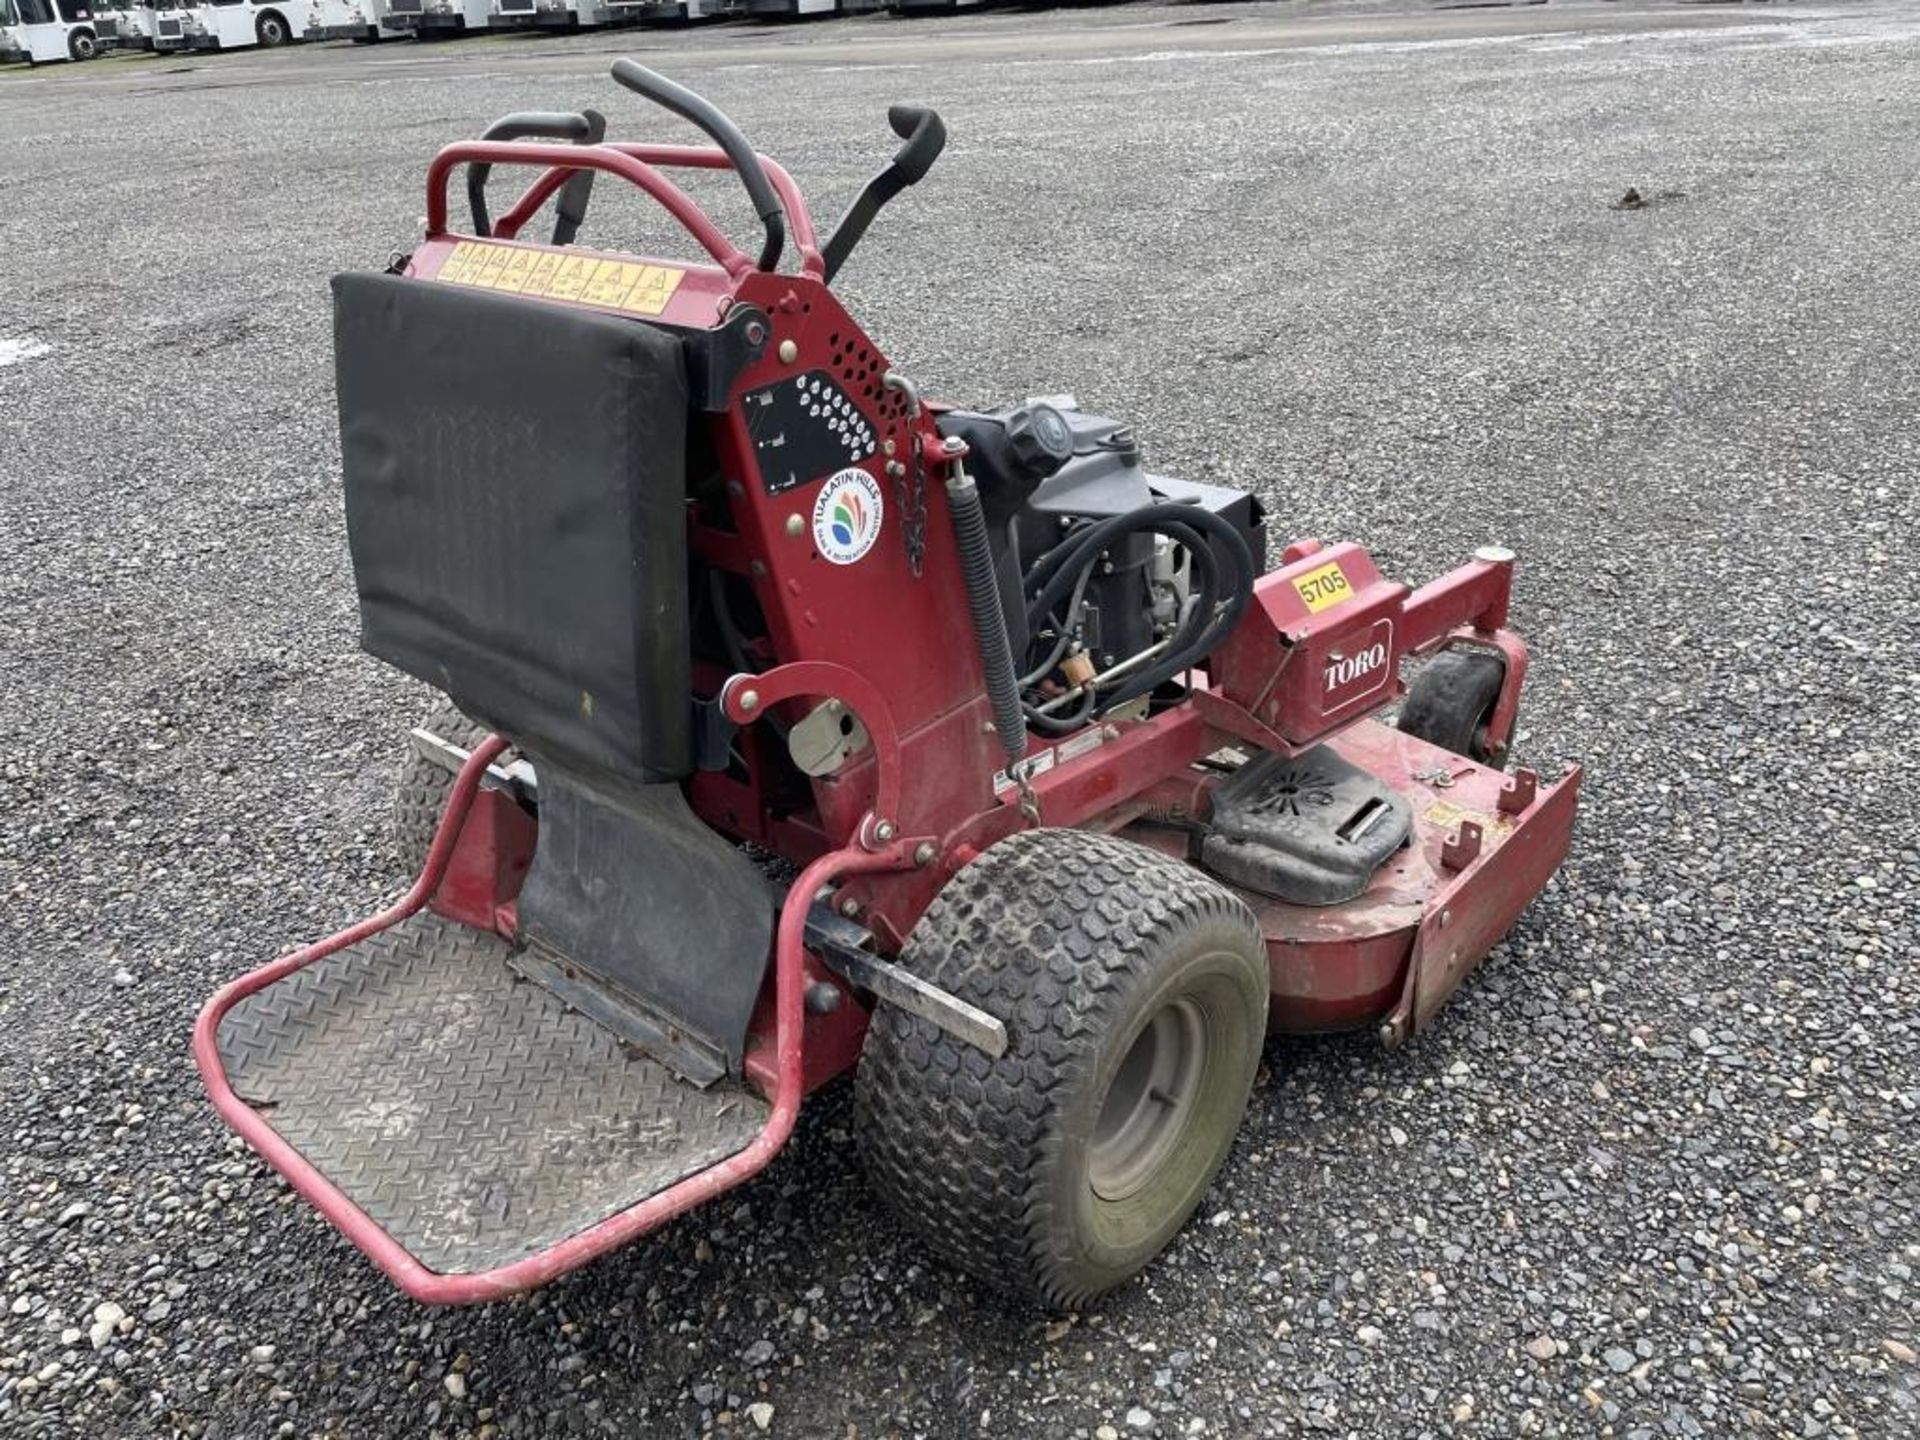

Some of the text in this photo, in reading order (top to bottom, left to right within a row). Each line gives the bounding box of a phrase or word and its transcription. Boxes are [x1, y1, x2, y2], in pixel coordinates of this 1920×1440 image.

[815, 472, 880, 526] TUALATIN HILLS
[1299, 571, 1346, 603] 5705
[1324, 643, 1385, 692] TORO
